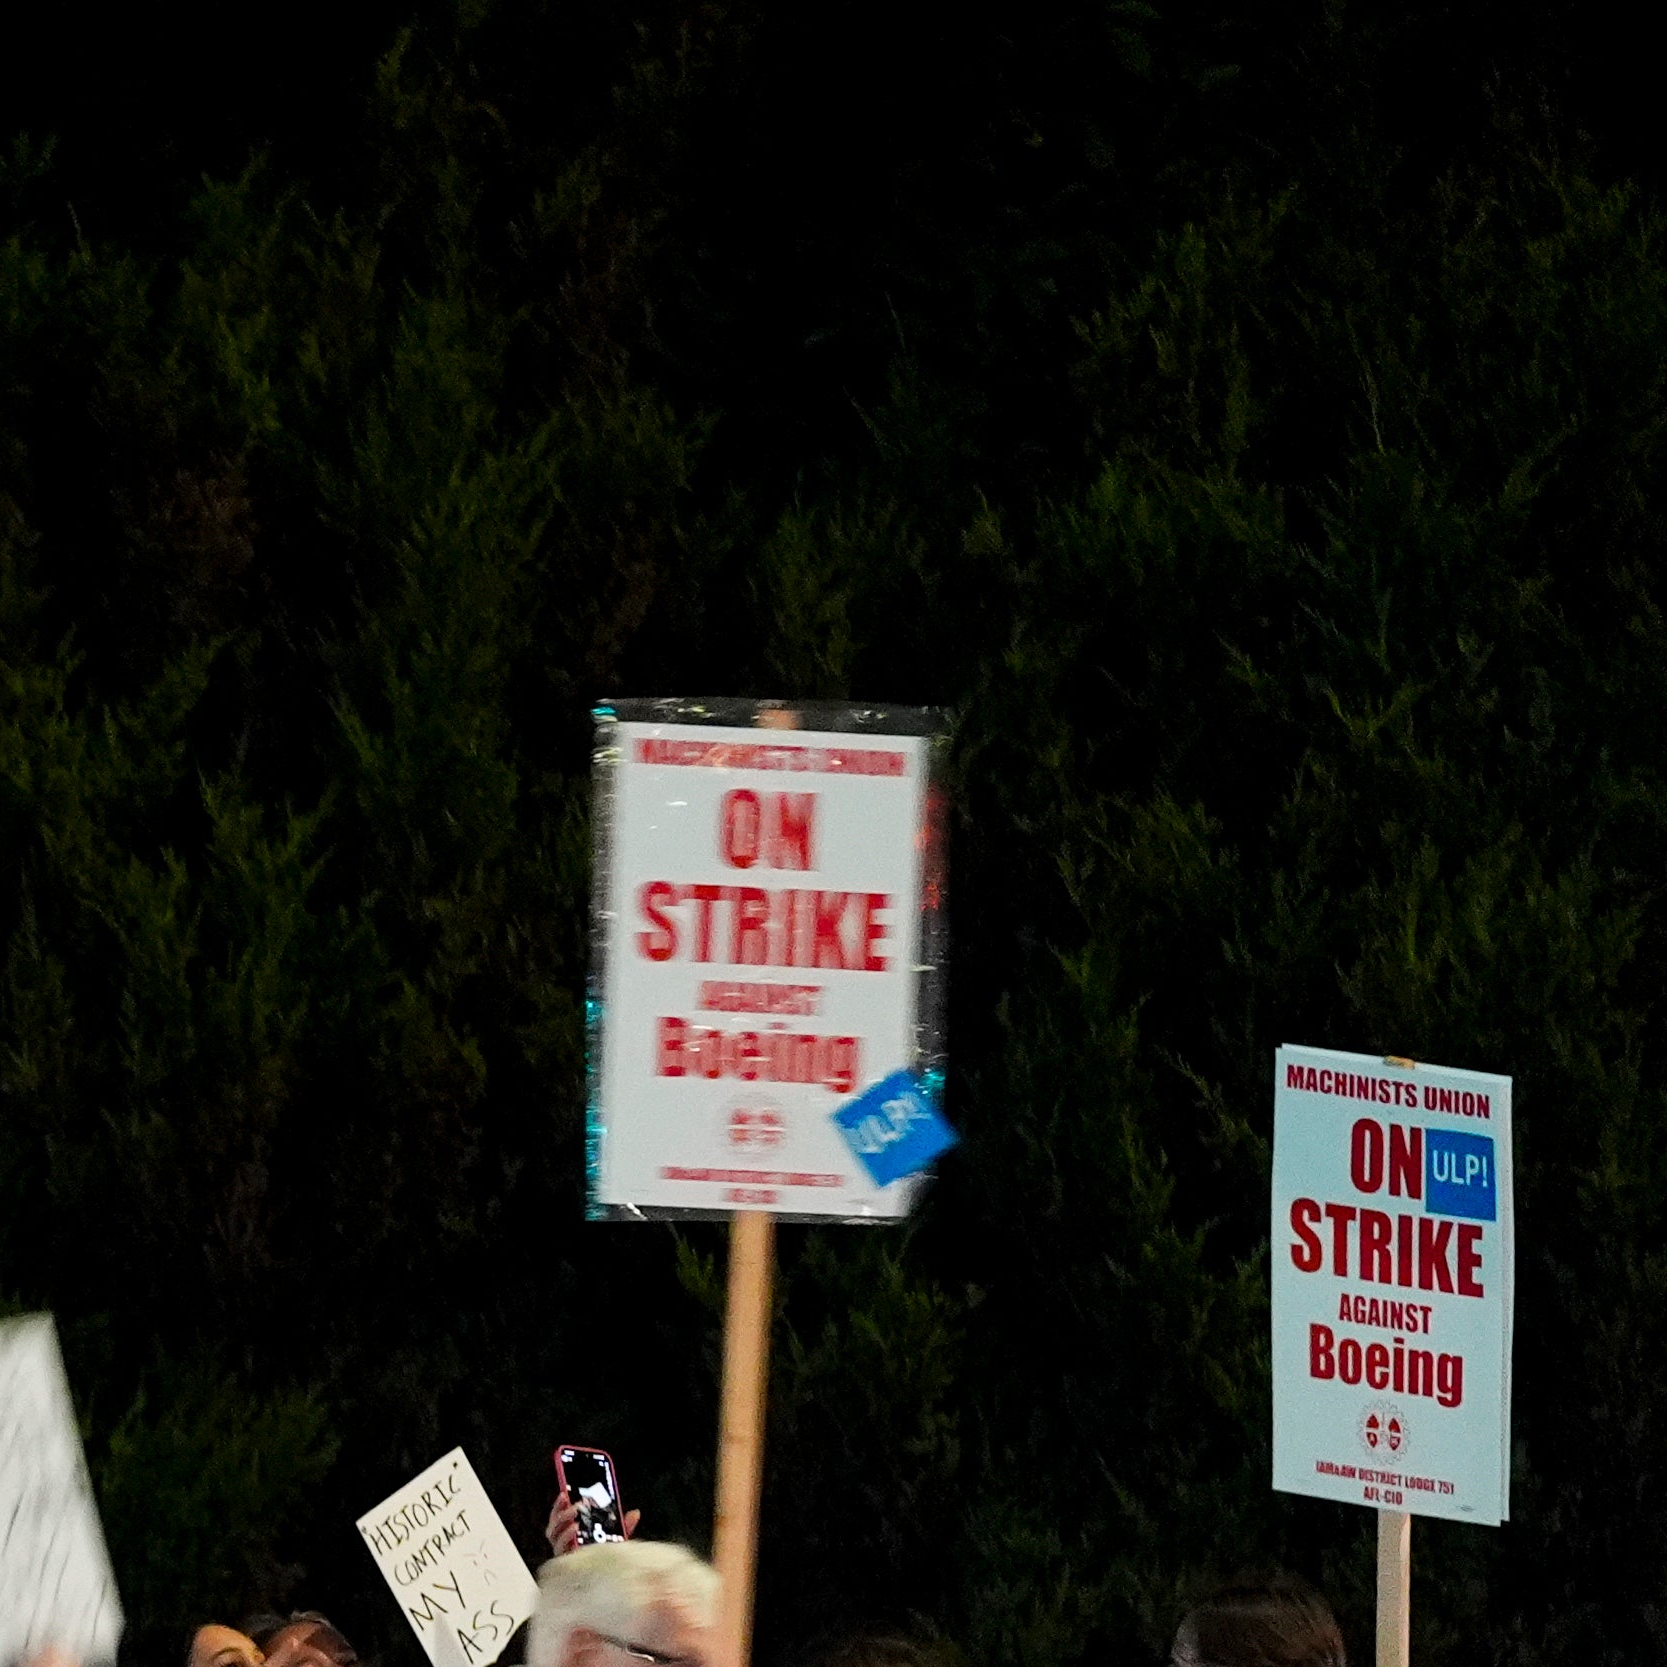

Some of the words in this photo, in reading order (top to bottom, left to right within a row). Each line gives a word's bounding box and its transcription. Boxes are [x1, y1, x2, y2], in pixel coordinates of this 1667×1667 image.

[720, 788, 820, 870] ON
[636, 880, 893, 972] STRIKE
[654, 1016, 860, 1093] Boeing
[1286, 1064, 1417, 1108] MACHINISTS
[1424, 1085, 1490, 1119] UNION
[1350, 1117, 1422, 1200] ON
[1433, 1150, 1489, 1187] ULP!
[1289, 1196, 1484, 1298] STRIKE
[1338, 1293, 1432, 1334] AGAINST
[1309, 1323, 1464, 1408] Boeing
[1358, 1467, 1402, 1486] DISTRICT
[1438, 1480, 1455, 1494] 751
[394, 1509, 471, 1586] CONTRACT
[408, 1570, 466, 1631] MY
[456, 1600, 515, 1665] ASS
